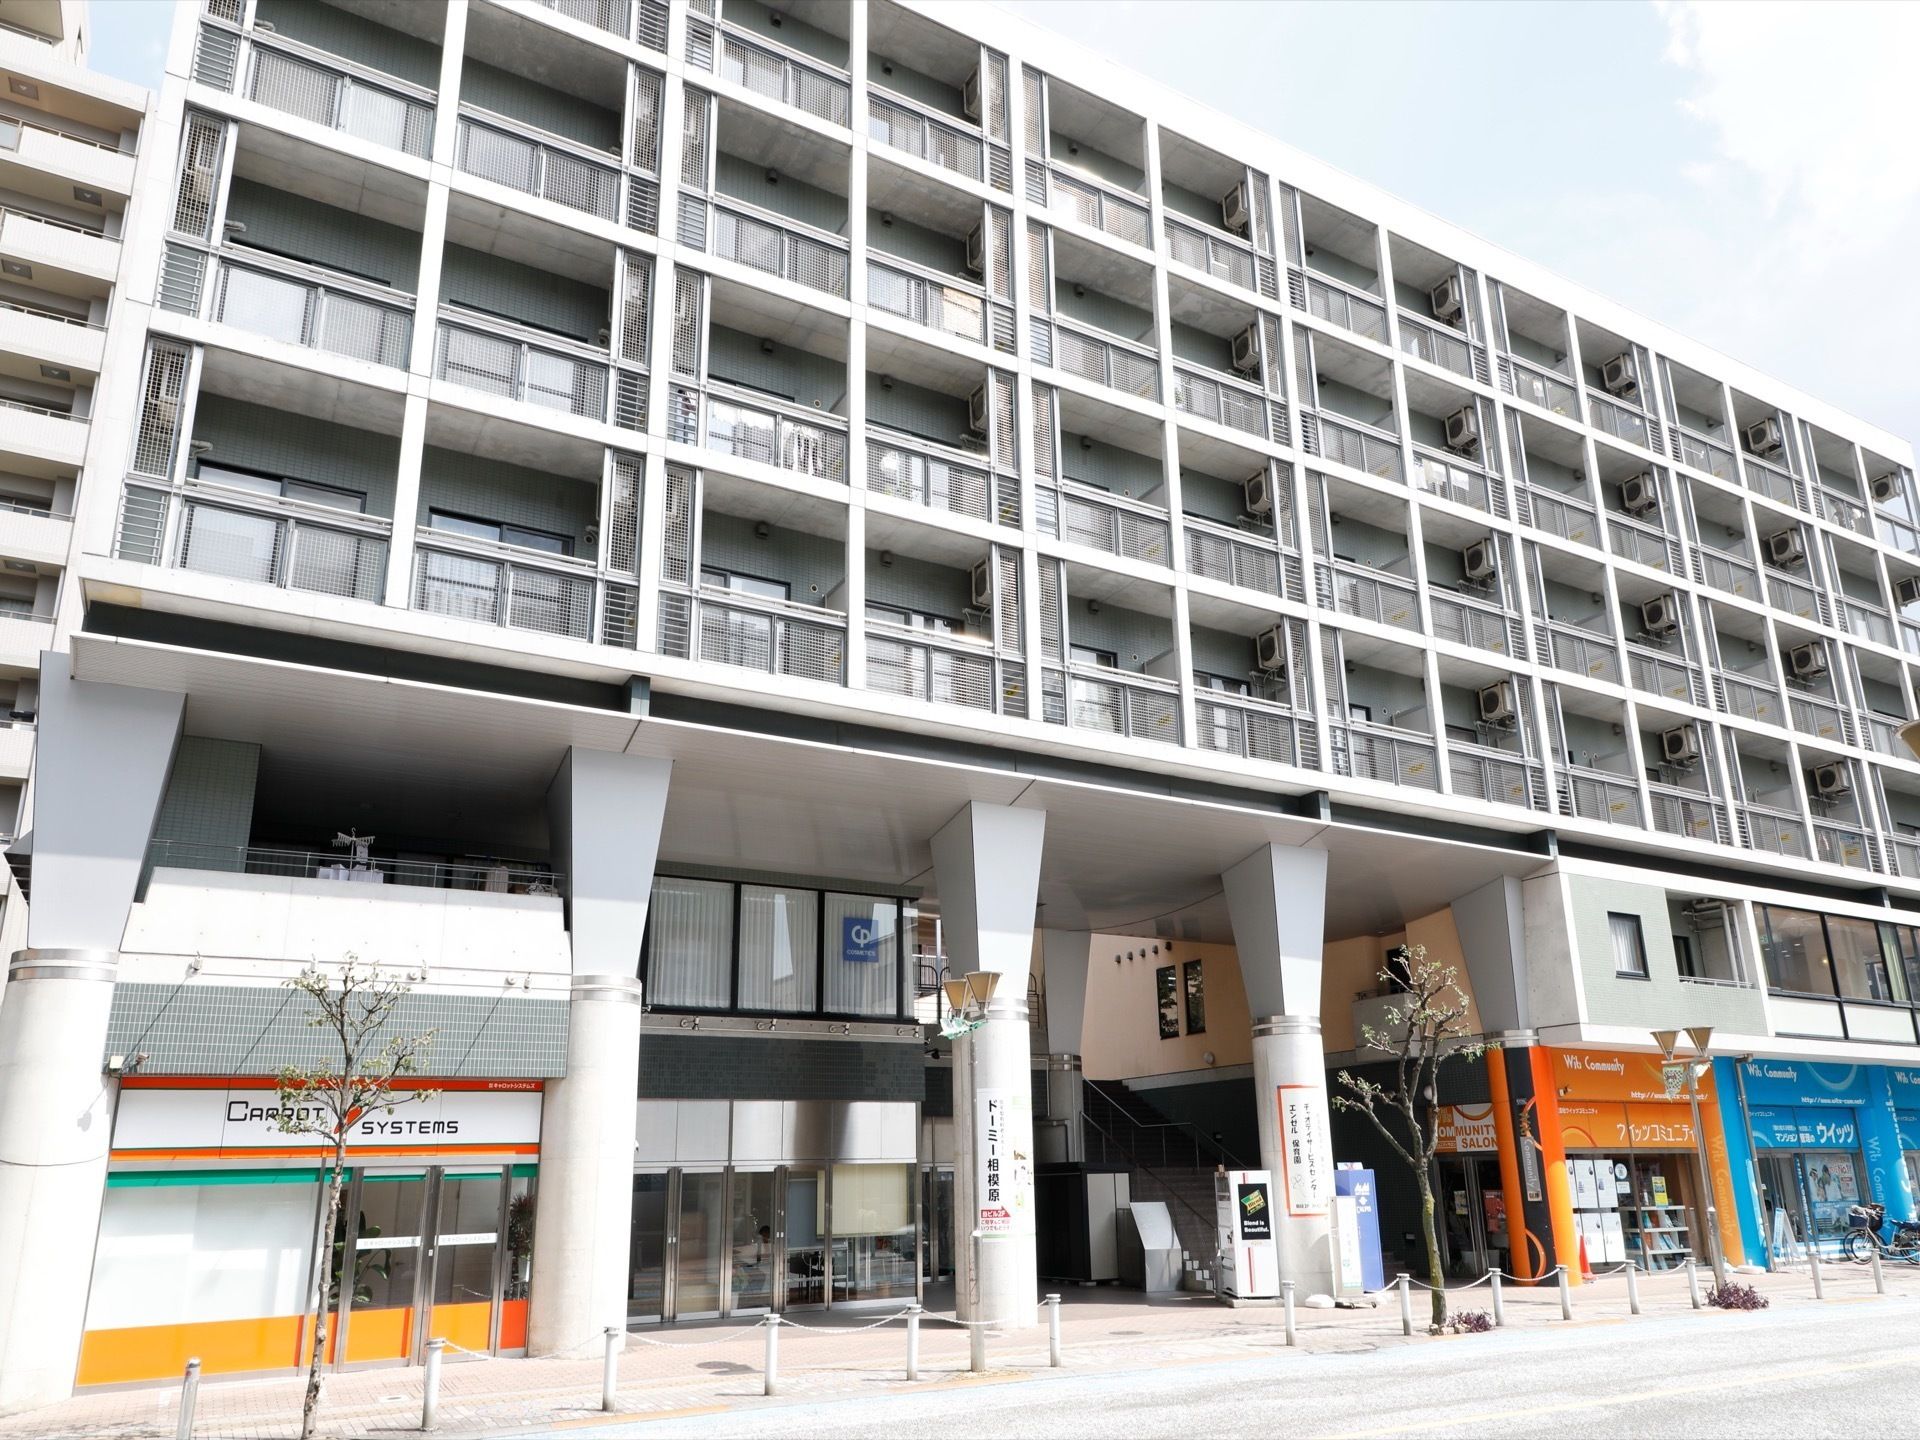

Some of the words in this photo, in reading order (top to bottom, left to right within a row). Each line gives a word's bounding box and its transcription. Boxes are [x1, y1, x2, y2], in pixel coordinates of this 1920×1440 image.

[1584, 1056, 1625, 1076] Community
[1763, 1064, 1797, 1083] Community
[361, 1120, 459, 1135] SYSTEMS
[1289, 1104, 1298, 1134] エンゼル
[1438, 1124, 1496, 1137] OMMUNITY
[1816, 1122, 1854, 1144] ウイッツ
[988, 1099, 1000, 1202] ドーミー相模原
